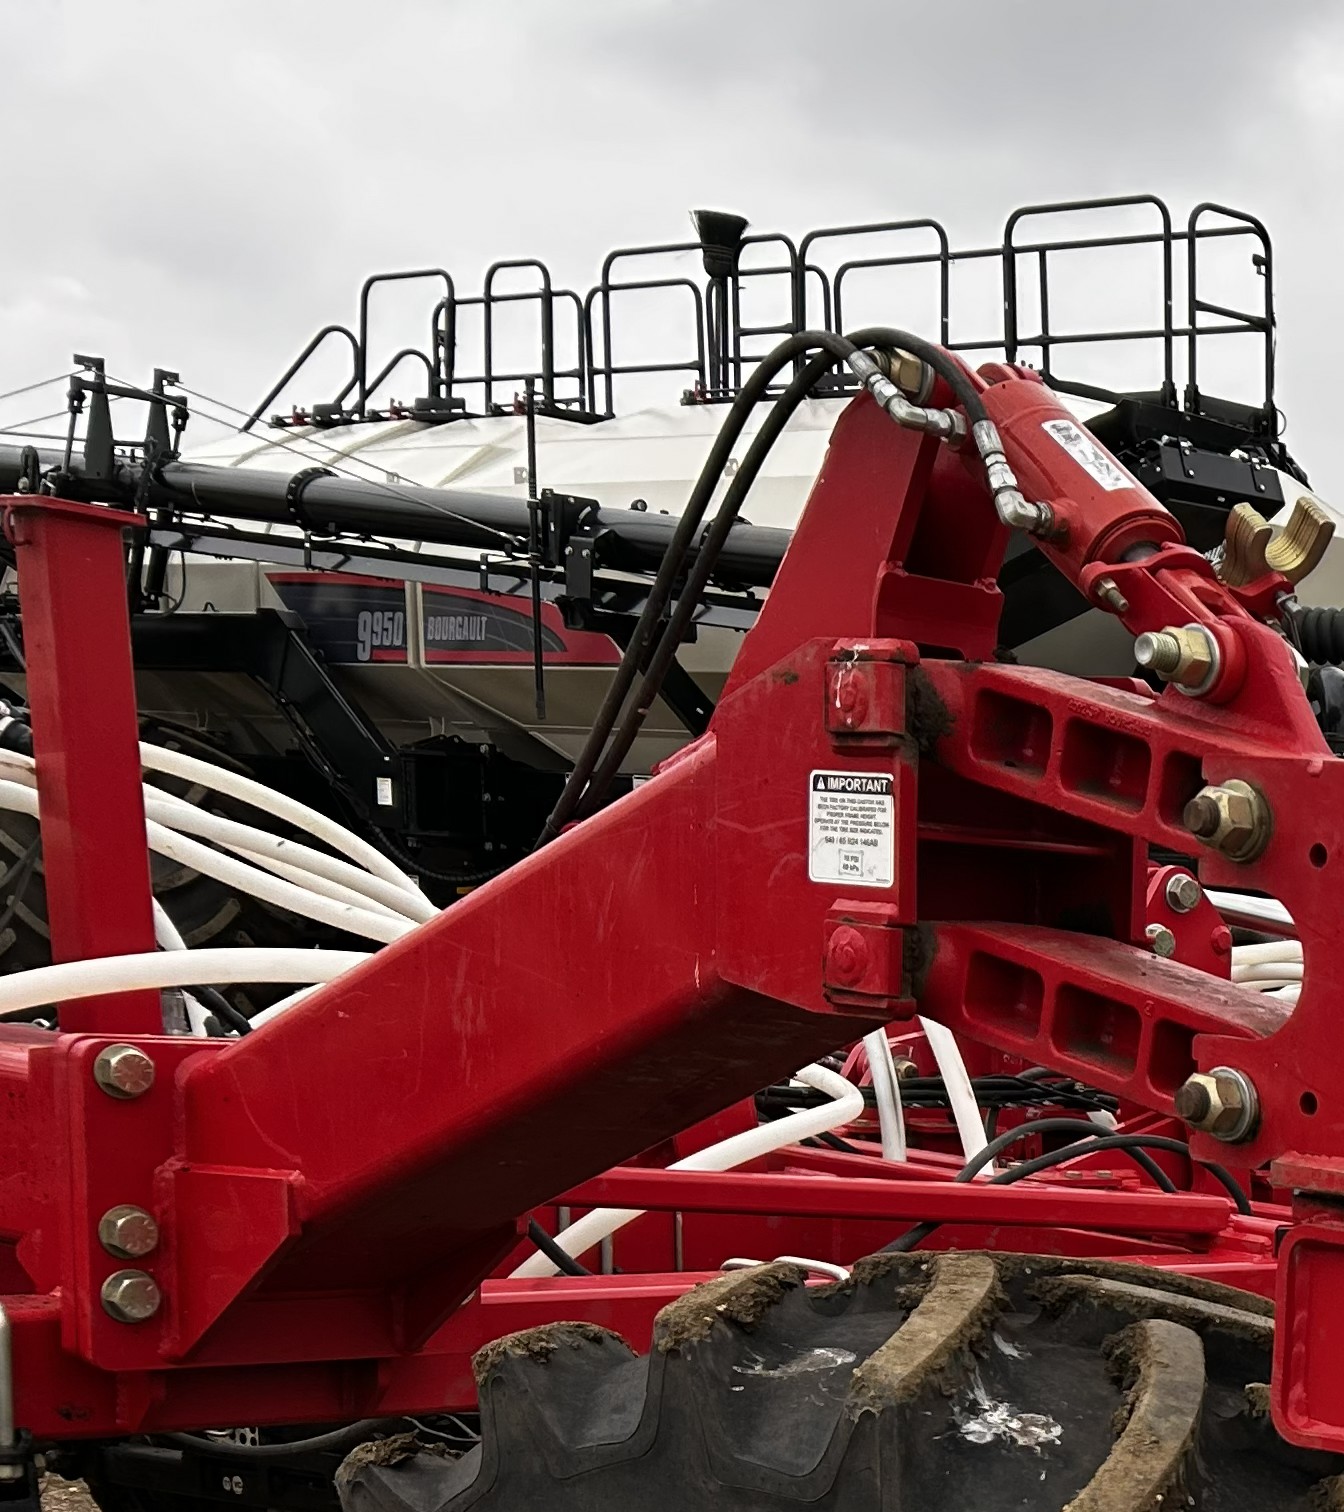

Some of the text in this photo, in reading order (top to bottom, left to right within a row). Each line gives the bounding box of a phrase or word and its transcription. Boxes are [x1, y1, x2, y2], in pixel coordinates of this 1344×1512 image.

[357, 611, 404, 661] 9950
[427, 616, 488, 641] BOURGAULT
[828, 776, 889, 793] IMPORTANT
